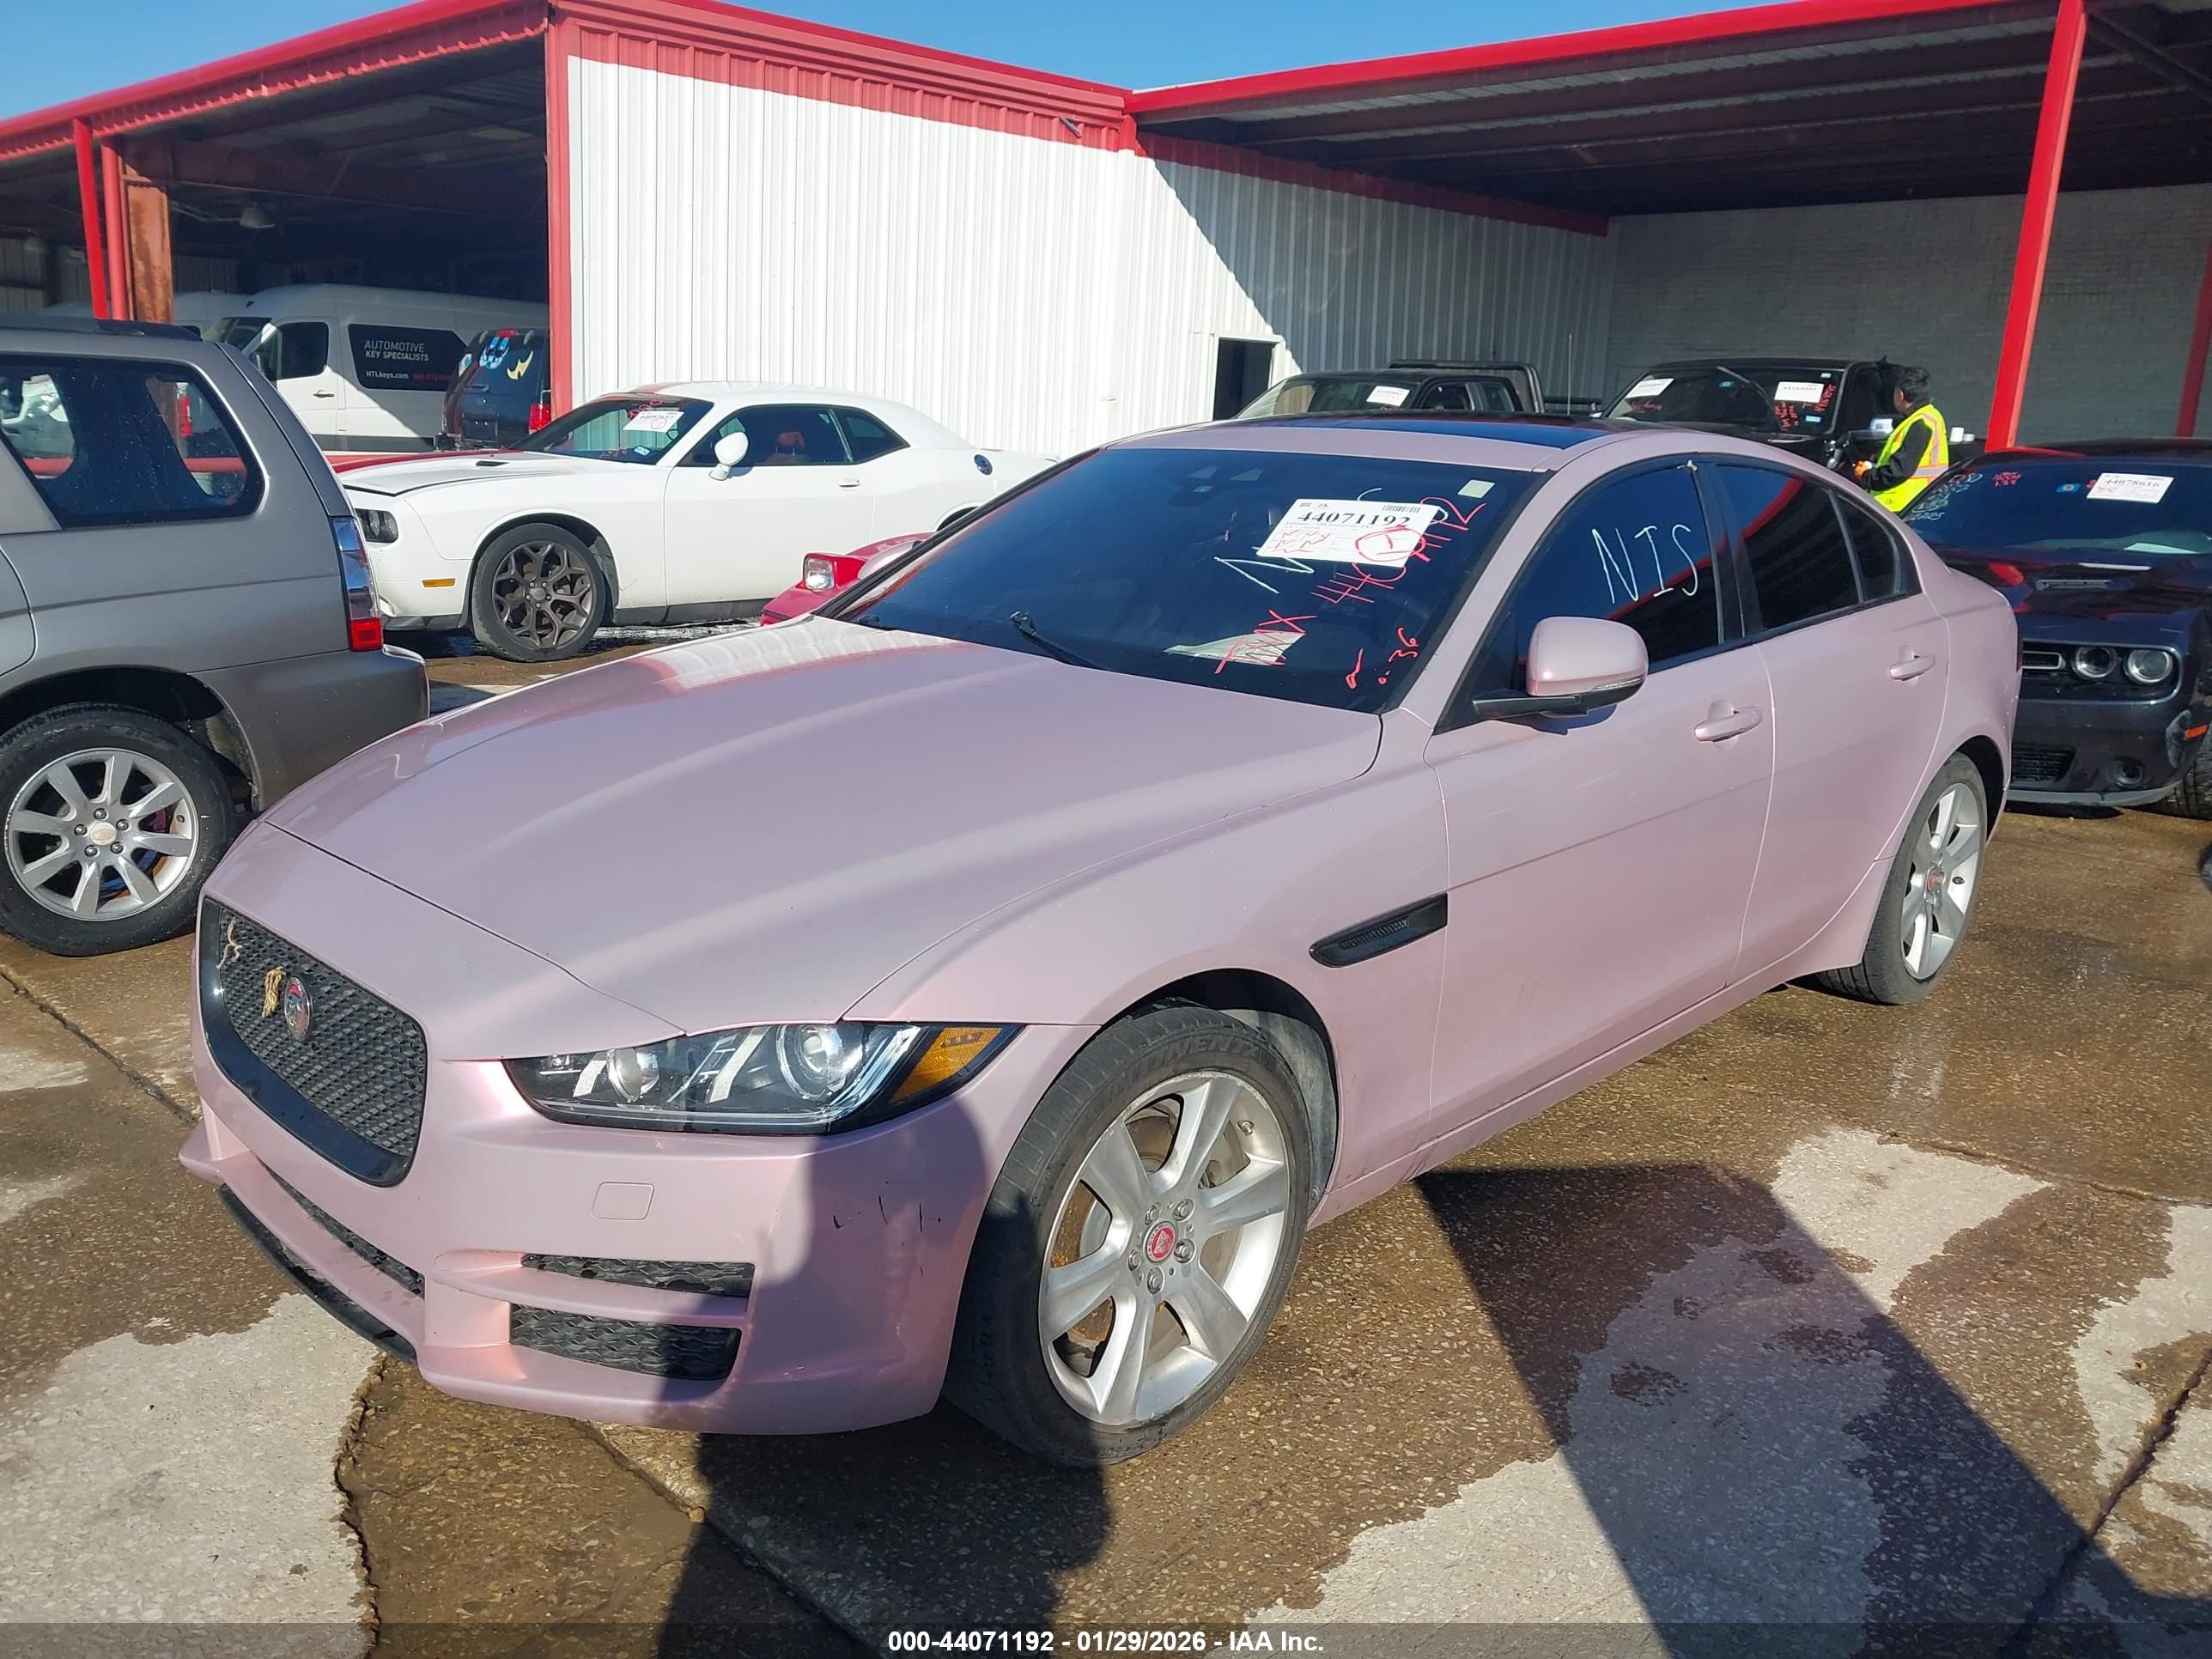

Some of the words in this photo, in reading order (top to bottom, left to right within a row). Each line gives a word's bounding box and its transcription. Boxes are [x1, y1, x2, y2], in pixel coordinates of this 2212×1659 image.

[364, 339, 425, 353] AUTOMOTIVE
[383, 351, 429, 362] SPECIALISTS
[1297, 510, 1412, 528] 44071192
